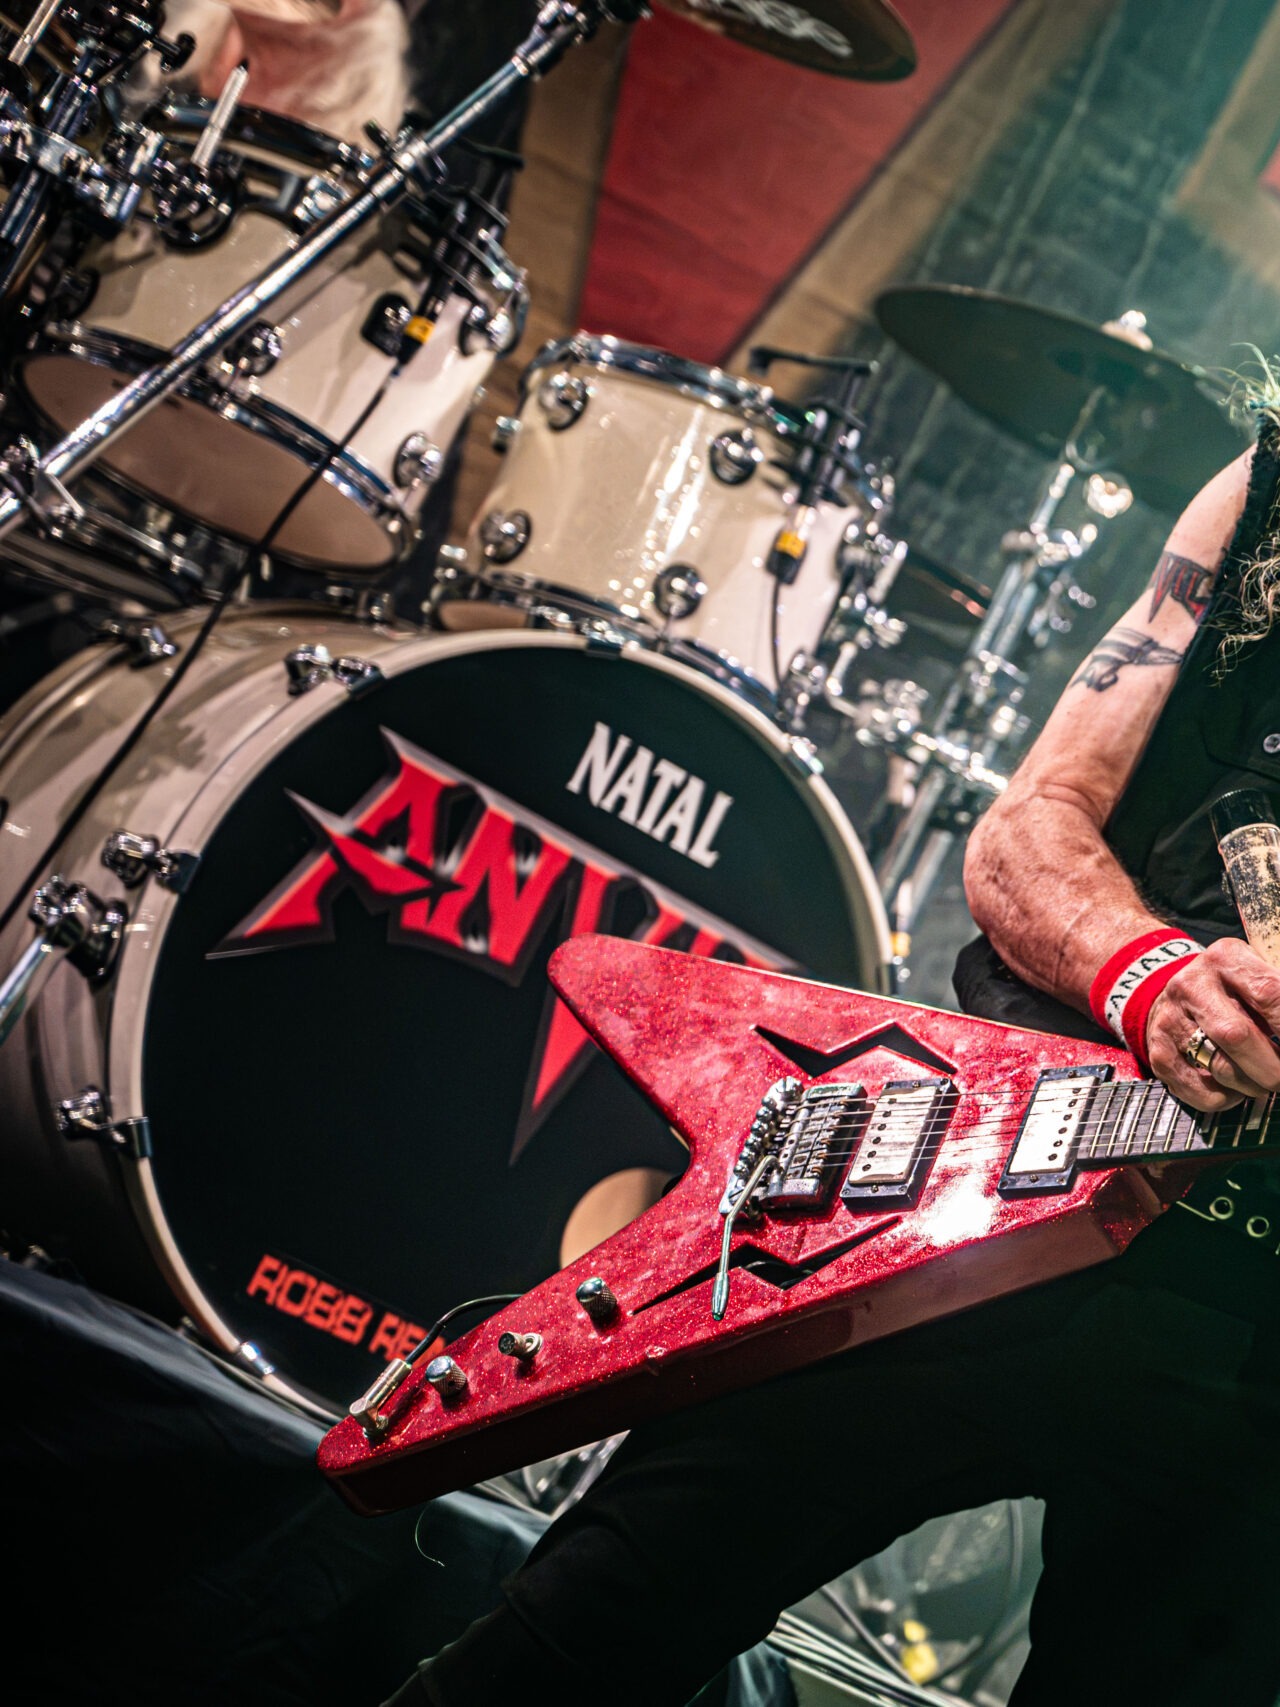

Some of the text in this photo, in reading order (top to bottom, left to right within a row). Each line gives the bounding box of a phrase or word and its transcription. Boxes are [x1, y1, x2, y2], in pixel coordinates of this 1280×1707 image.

[565, 721, 734, 869] NATAL
[1106, 940, 1204, 1022] ANAD
[247, 1254, 373, 1344] ROBB
